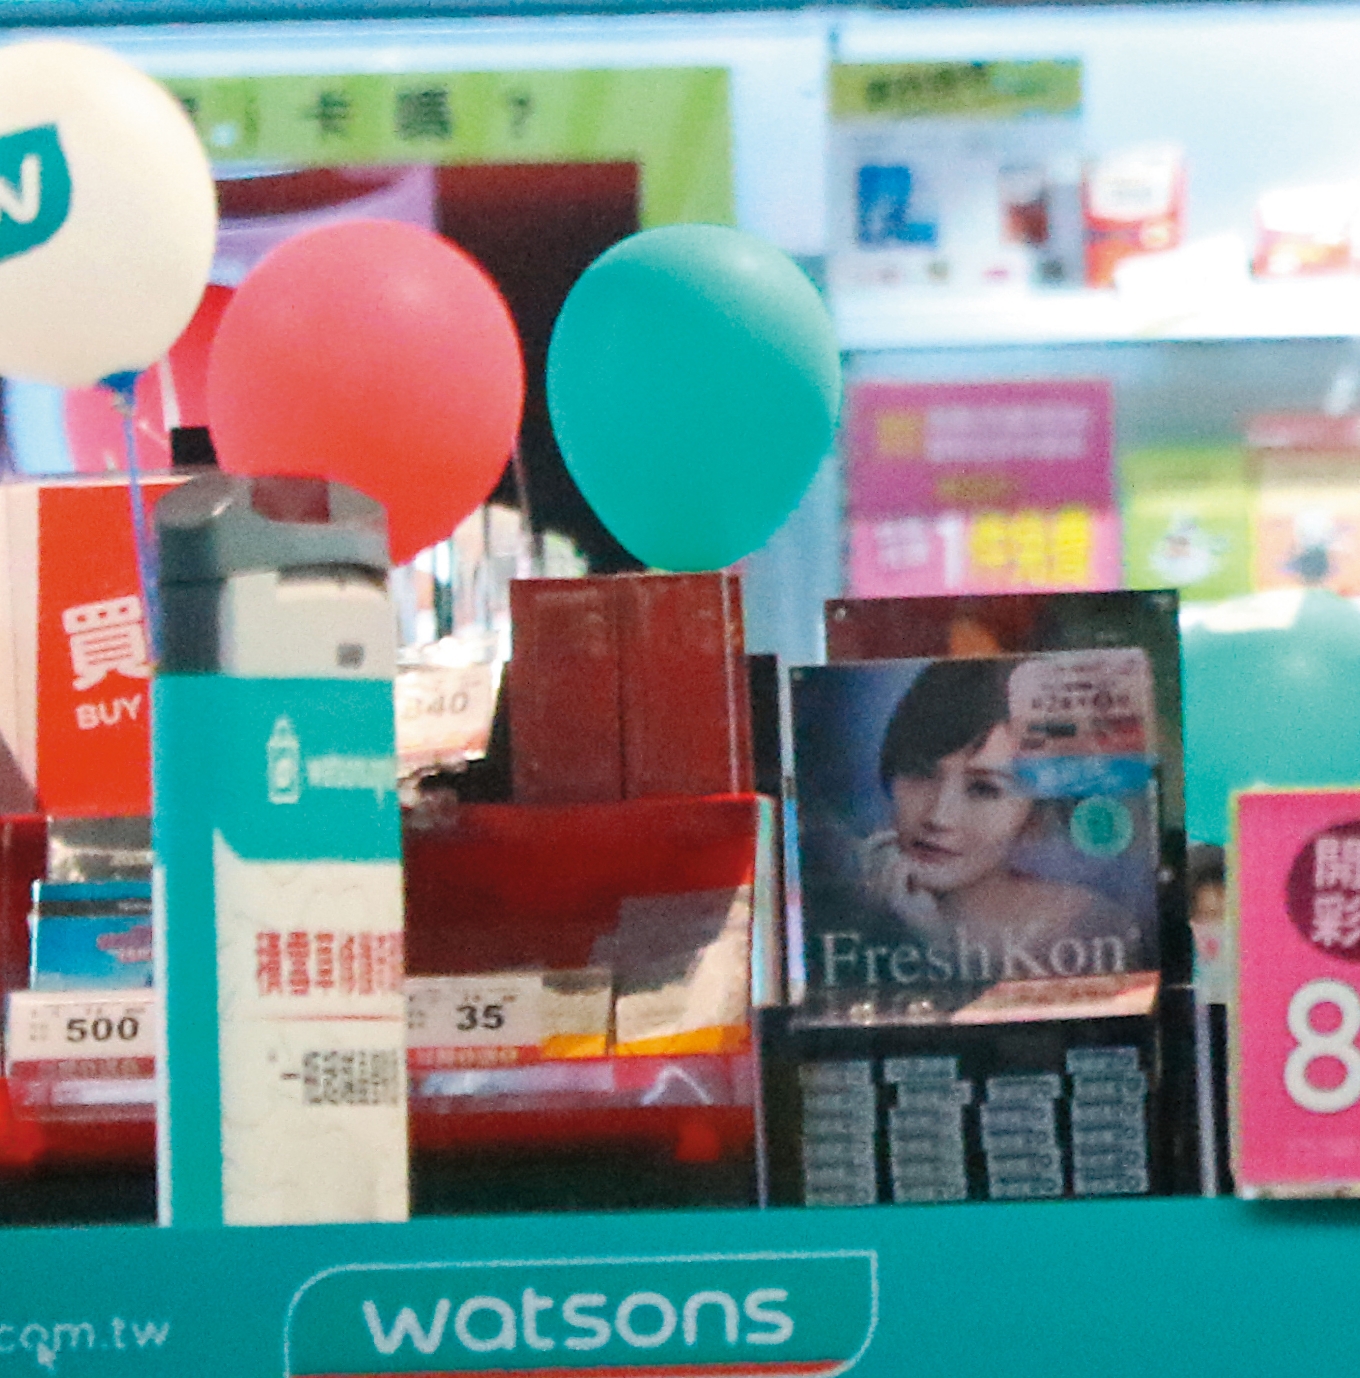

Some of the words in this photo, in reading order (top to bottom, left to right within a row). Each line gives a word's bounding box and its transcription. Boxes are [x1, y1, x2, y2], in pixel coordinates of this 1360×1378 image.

[62, 595, 152, 692] 買
[75, 694, 142, 730] BUY
[821, 925, 1125, 984] FreshKon
[66, 1017, 139, 1044] 500
[456, 1003, 505, 1032] 35
[362, 1286, 795, 1355] watsons
